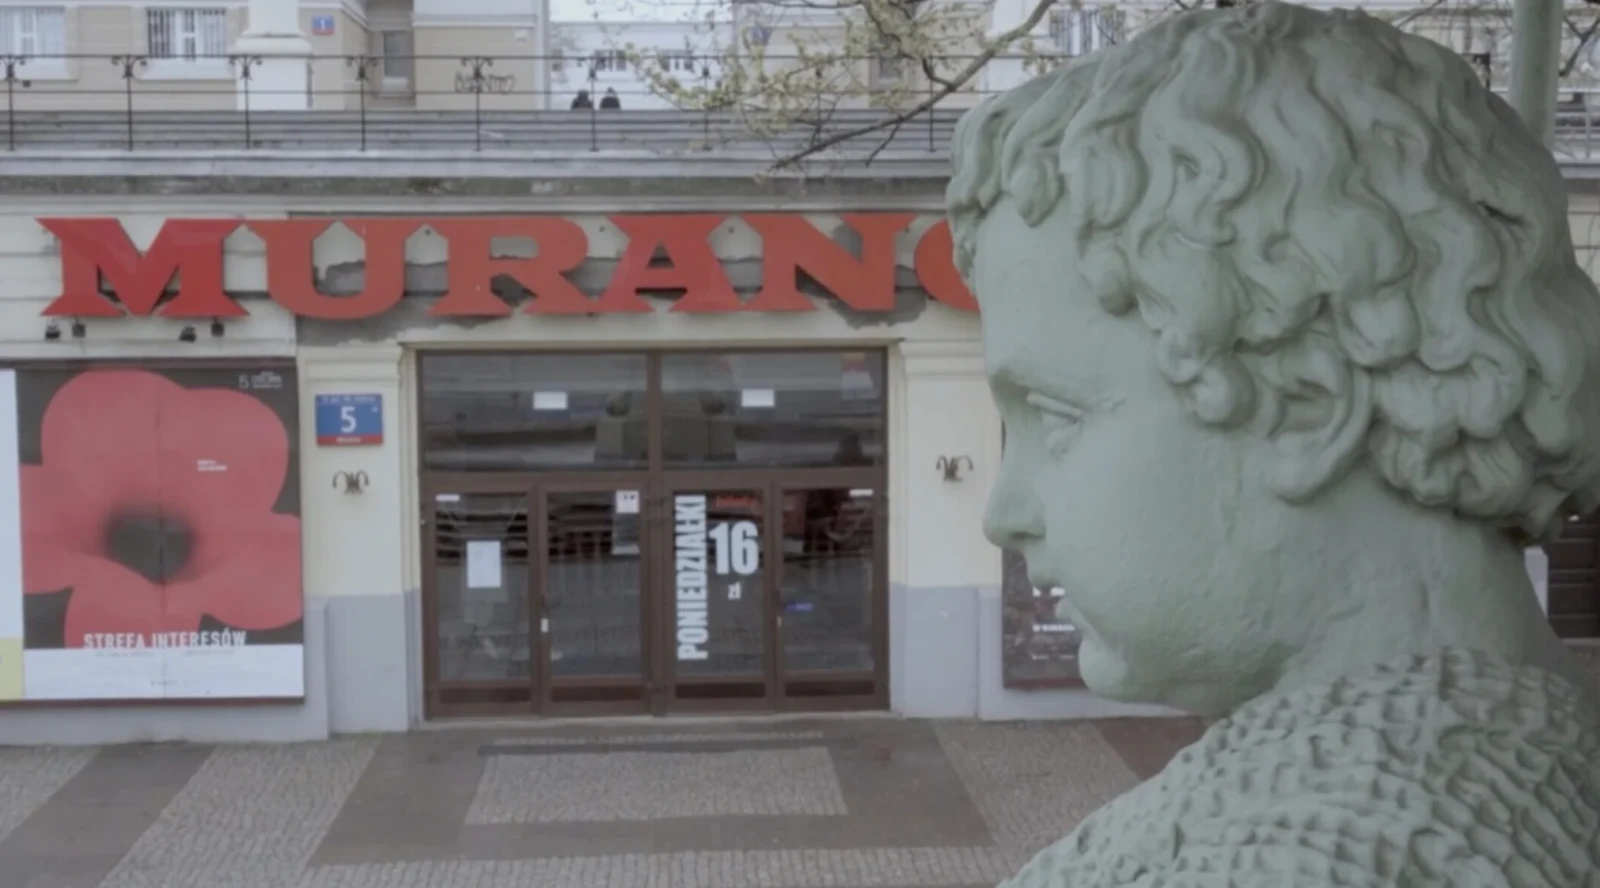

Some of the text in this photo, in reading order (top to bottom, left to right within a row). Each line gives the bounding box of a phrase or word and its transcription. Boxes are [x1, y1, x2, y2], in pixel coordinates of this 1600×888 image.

[341, 405, 357, 434] 5
[708, 521, 758, 575] 16
[675, 495, 708, 660] PONIEDZIAŁKI
[83, 627, 247, 648] STREFA INTERESÓW
